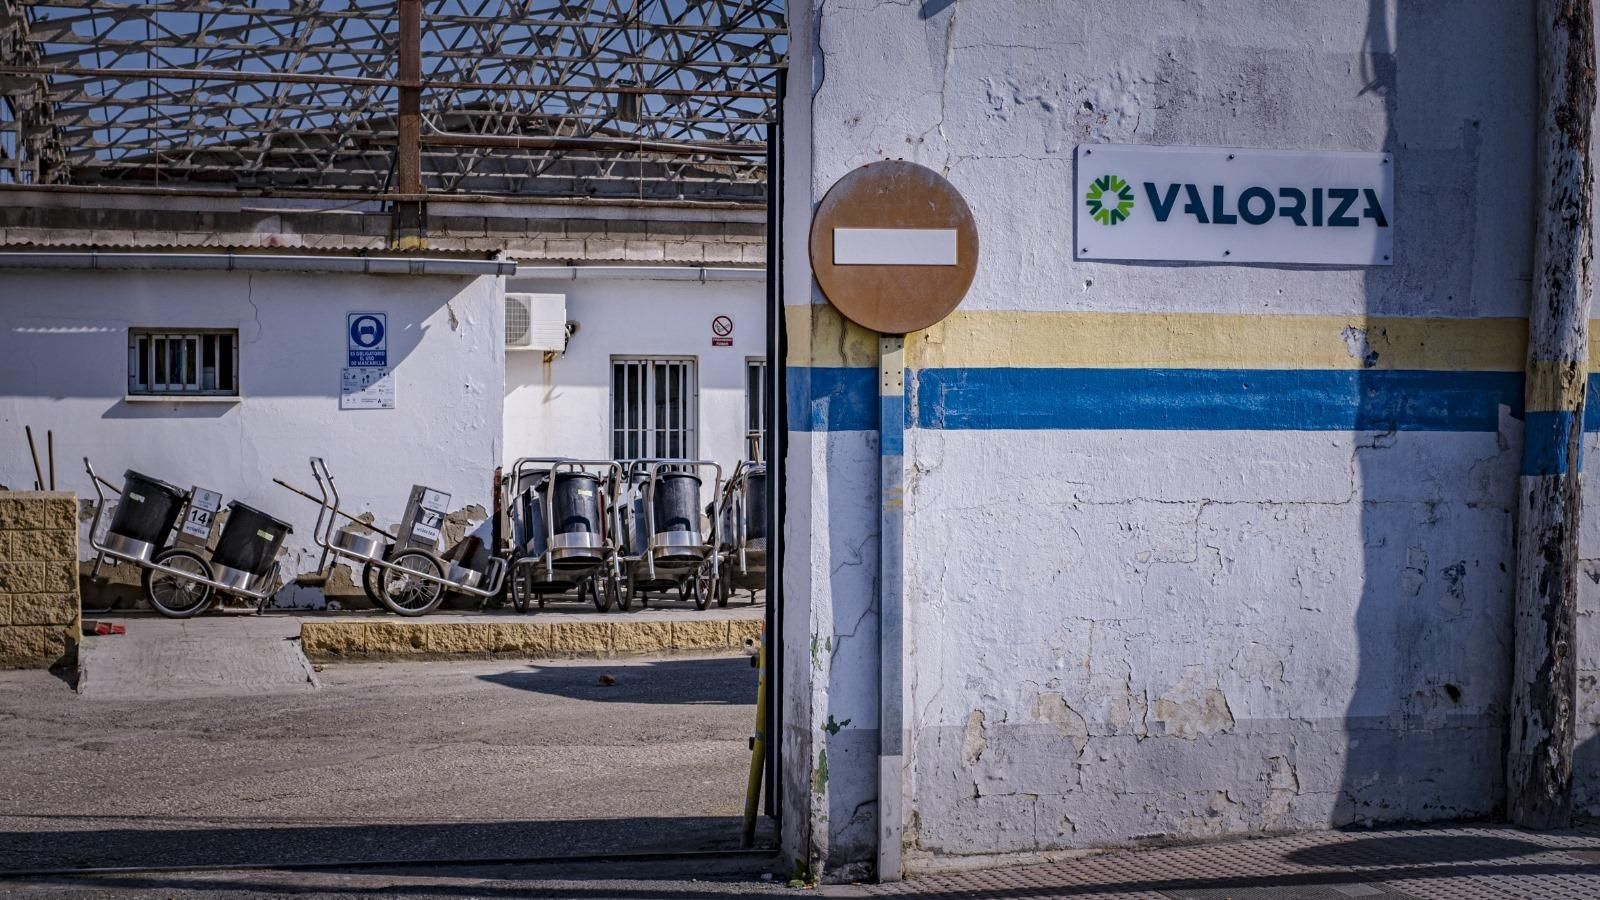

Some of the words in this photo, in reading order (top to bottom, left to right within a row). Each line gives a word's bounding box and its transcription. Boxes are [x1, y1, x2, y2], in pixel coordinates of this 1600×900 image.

[1143, 181, 1389, 228] VALORIZA
[191, 510, 207, 524] 14
[427, 512, 437, 524] 7
